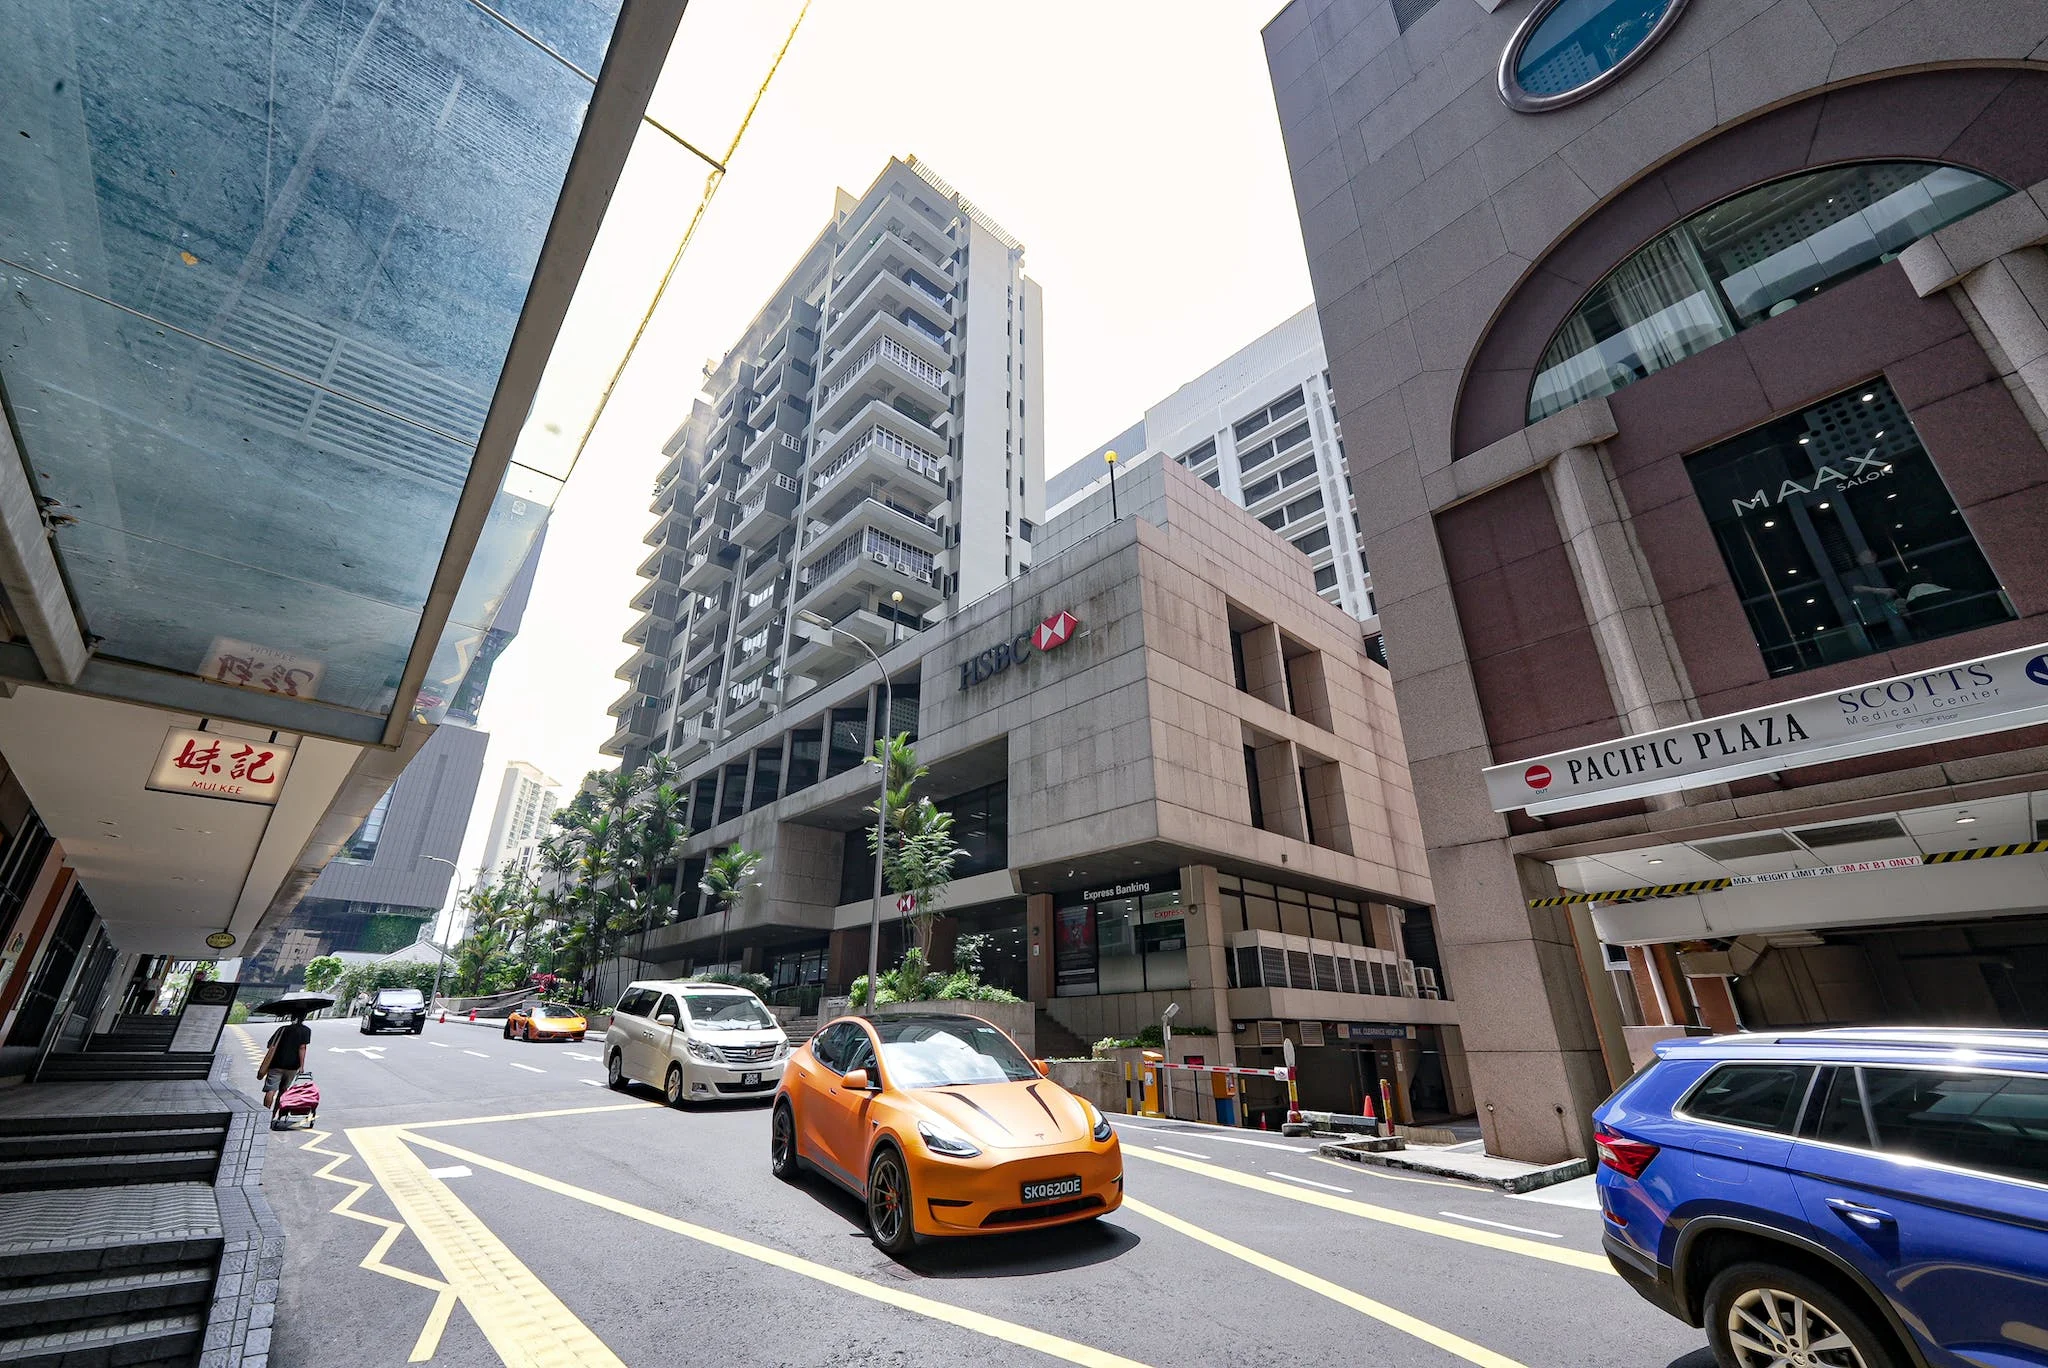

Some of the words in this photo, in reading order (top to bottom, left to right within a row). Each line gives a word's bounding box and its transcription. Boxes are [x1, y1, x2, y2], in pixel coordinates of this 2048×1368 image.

[1731, 447, 1888, 517] MAAX
[1836, 465, 1894, 492] SALON
[958, 629, 1031, 692] HSBC
[1838, 662, 1993, 714] SCOTTS
[1845, 703, 1919, 726] Medical
[1932, 687, 2000, 708] Center
[173, 738, 275, 784] 妹記
[1566, 738, 1683, 785] PACIFIC
[1692, 713, 1810, 760] PLAZA
[191, 780, 217, 791] MUI
[219, 782, 245, 795] KEE
[1732, 877, 1754, 886] MAX.
[1757, 871, 1790, 883] HEIGHT
[1791, 869, 1817, 879] LIMIT
[1818, 866, 1835, 876] 2M
[1836, 863, 1856, 874] (3M
[1858, 862, 1871, 871] AT
[1872, 860, 1887, 870] B1
[1890, 857, 1921, 868] ONLY)
[1083, 887, 1115, 901] Express
[1115, 882, 1150, 896] Banking
[1154, 908, 1185, 920] Express
[1024, 1178, 1081, 1200] SKQ6200E
